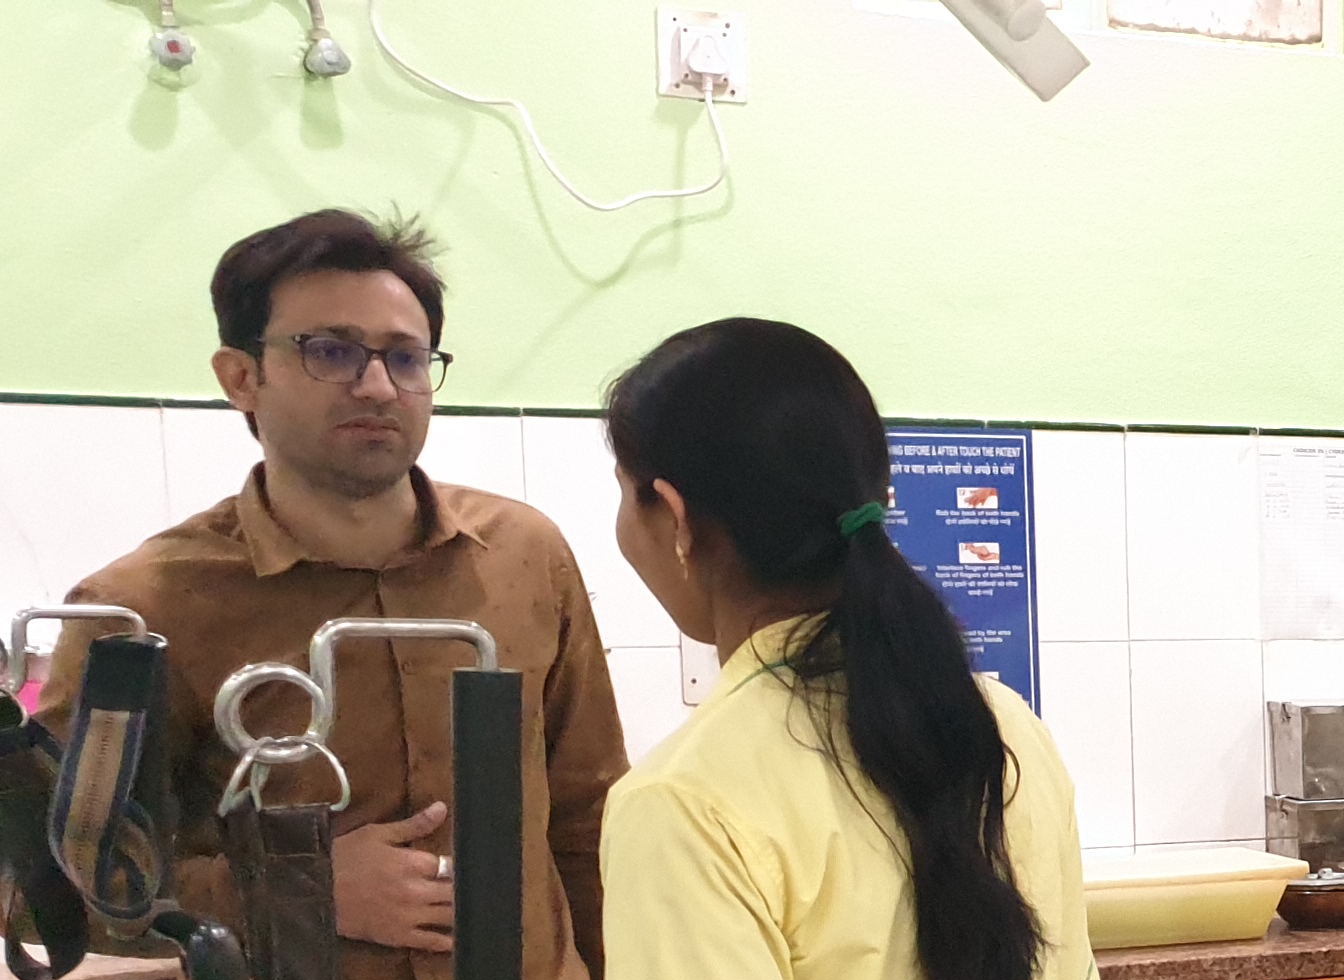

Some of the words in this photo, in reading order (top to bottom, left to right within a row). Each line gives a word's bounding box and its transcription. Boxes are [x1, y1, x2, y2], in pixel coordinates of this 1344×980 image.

[904, 445, 930, 456] BEFORE
[938, 445, 958, 456] AFTER
[960, 446, 981, 457] TOUCH
[982, 446, 994, 457] THE
[995, 447, 1021, 457] PATIENT
